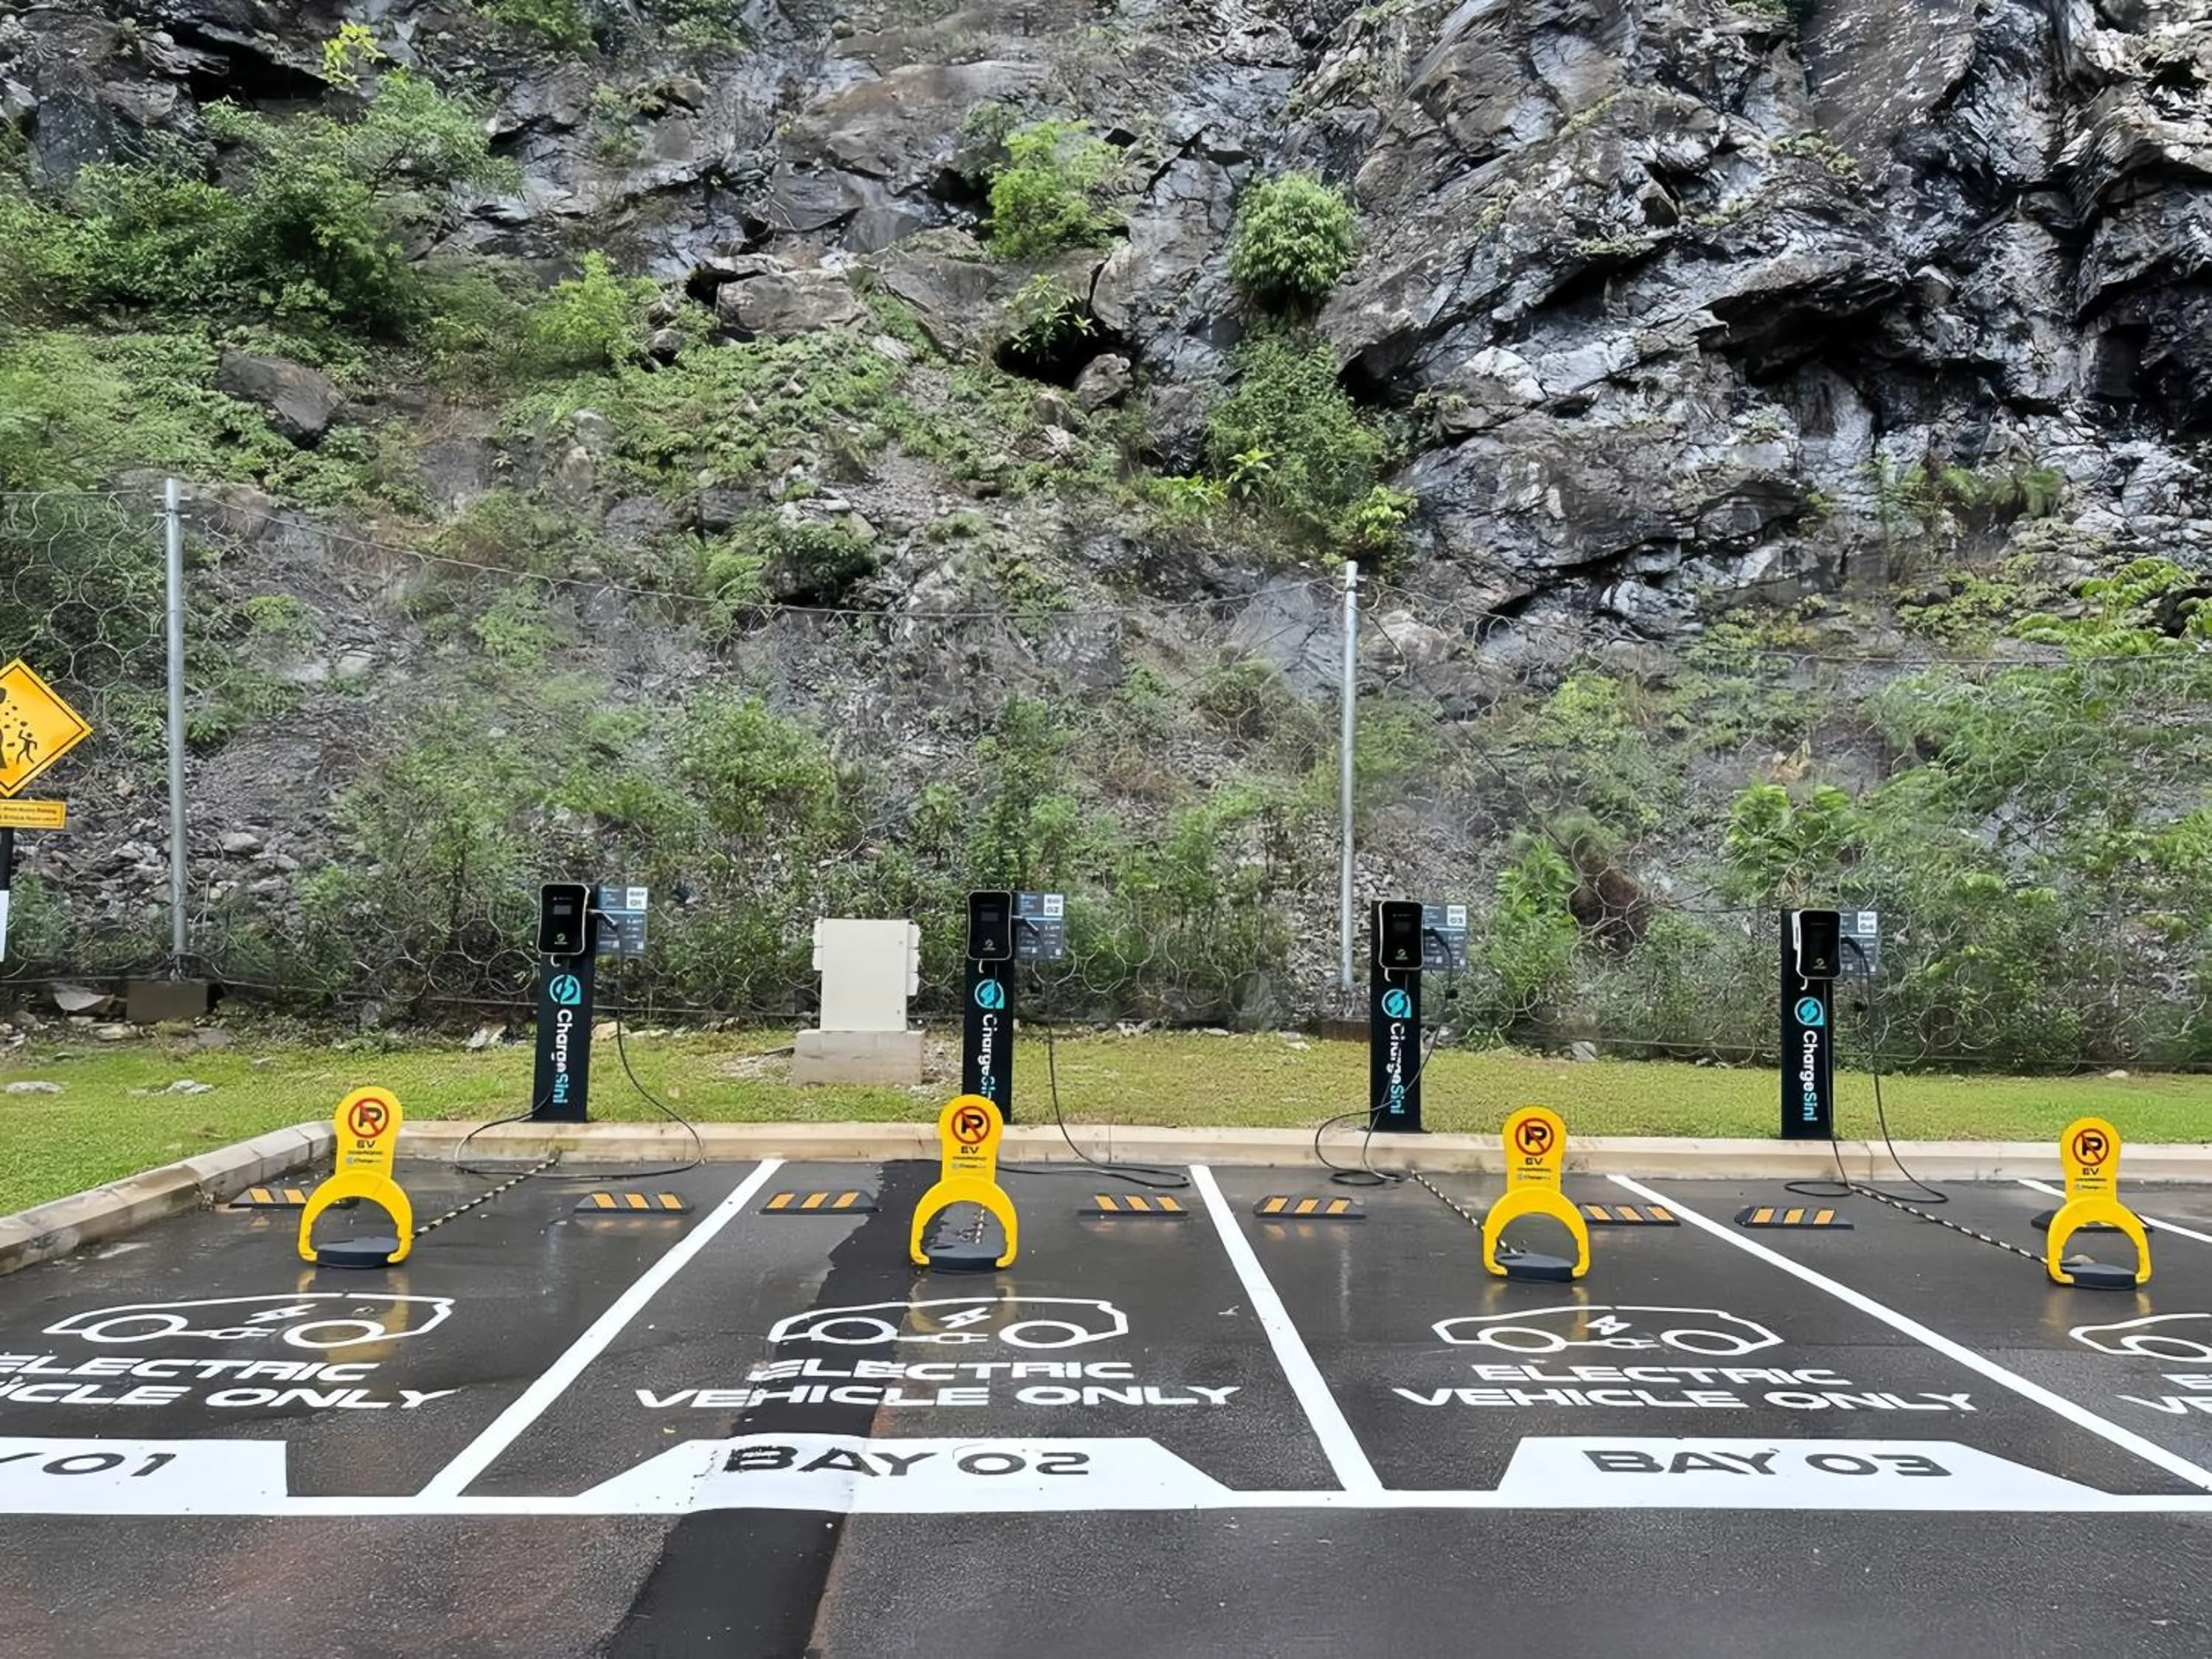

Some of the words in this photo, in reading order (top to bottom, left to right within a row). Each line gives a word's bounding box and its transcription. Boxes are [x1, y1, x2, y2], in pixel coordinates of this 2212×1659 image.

[551, 1009, 573, 1103] ChargeSini
[1799, 1030, 1818, 1121] ChargeSini
[356, 1140, 375, 1149] EV
[748, 1359, 1135, 1382] ELECTRIC
[1471, 1364, 1852, 1386] ELECTRIC
[205, 1388, 461, 1409] ONLY
[635, 1386, 990, 1408] VEHICLE
[1015, 1385, 1240, 1406] ONLY
[1392, 1388, 1750, 1409] VEHICLE
[1764, 1391, 1978, 1411] ONLY
[723, 1445, 938, 1477] BAY
[960, 1451, 1091, 1475] 02
[1582, 1450, 1774, 1475] BAY
[1804, 1453, 1952, 1477] 03
